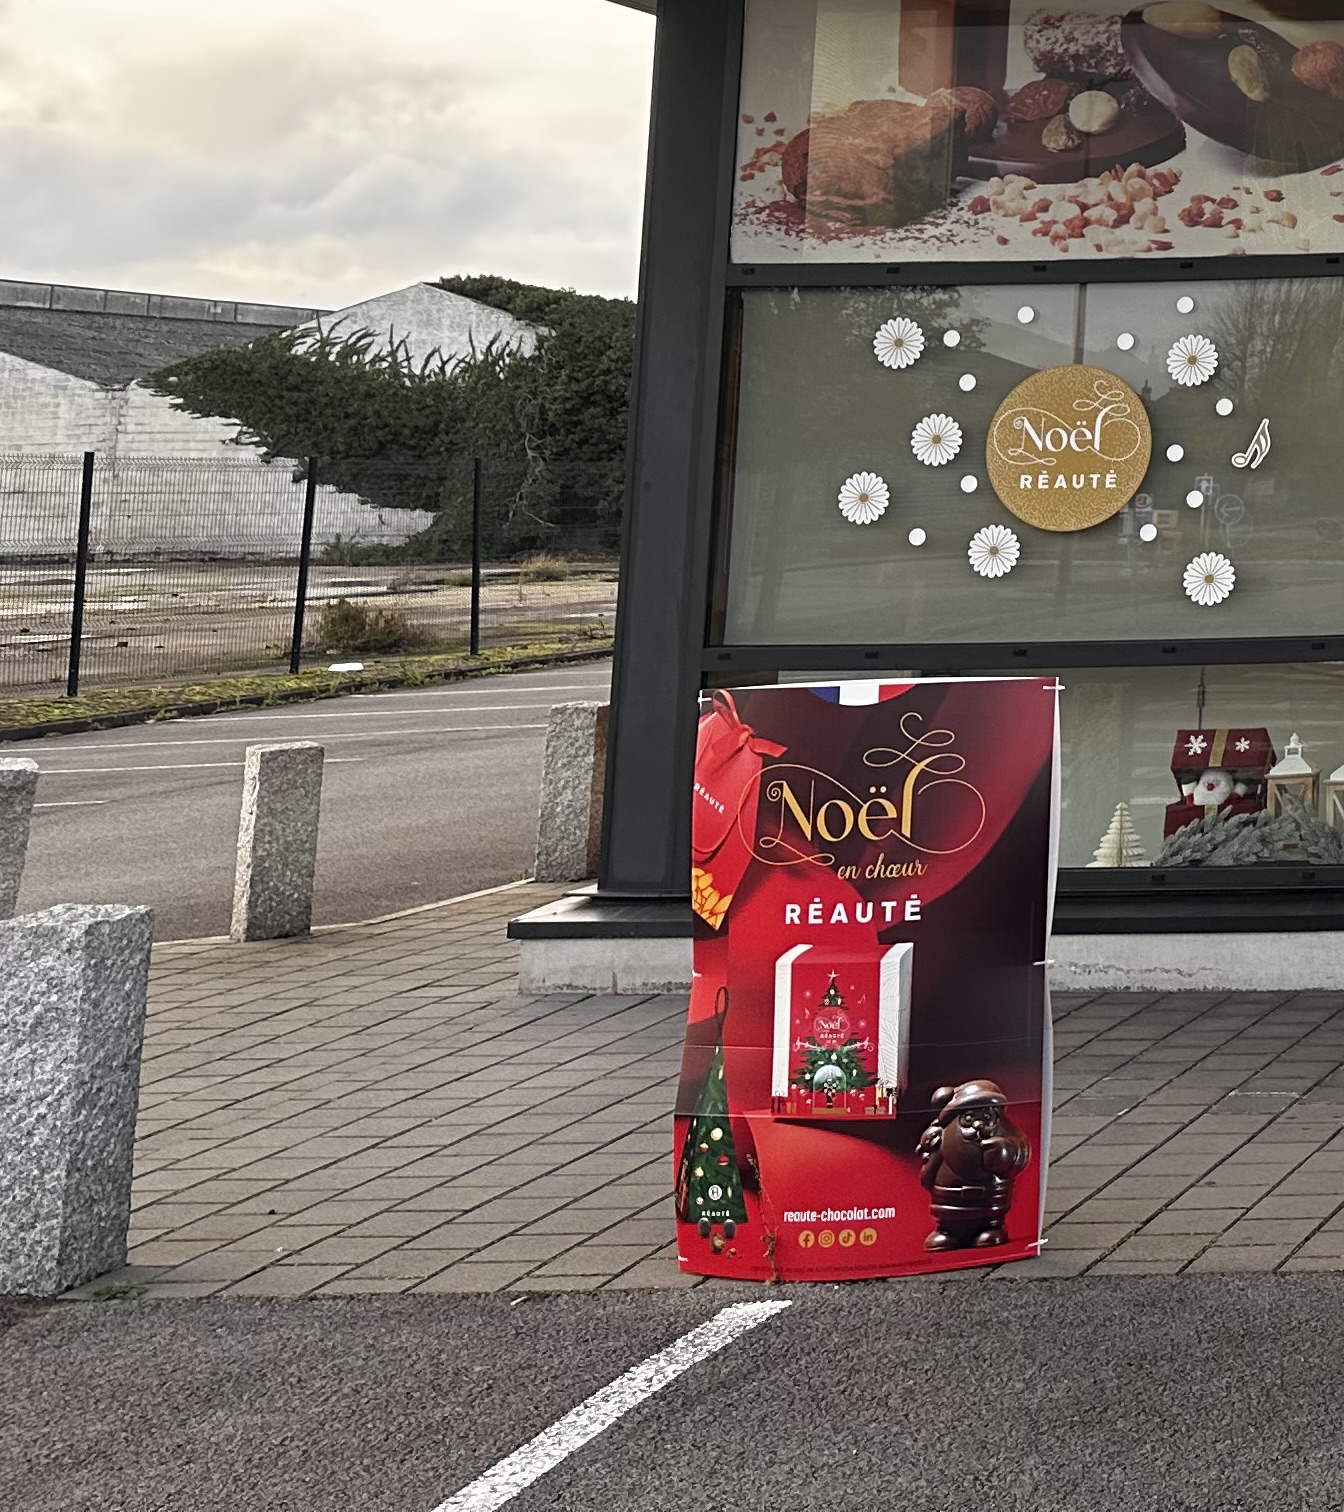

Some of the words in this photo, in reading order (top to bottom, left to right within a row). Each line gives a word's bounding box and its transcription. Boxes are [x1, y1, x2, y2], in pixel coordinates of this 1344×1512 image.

[1019, 470, 1118, 489] RÉAUTÉ
[837, 863, 861, 879] en
[865, 852, 928, 879] chœur
[785, 894, 923, 925] RÉAUTÉ
[783, 1205, 896, 1223] reaute-chocolat.com
